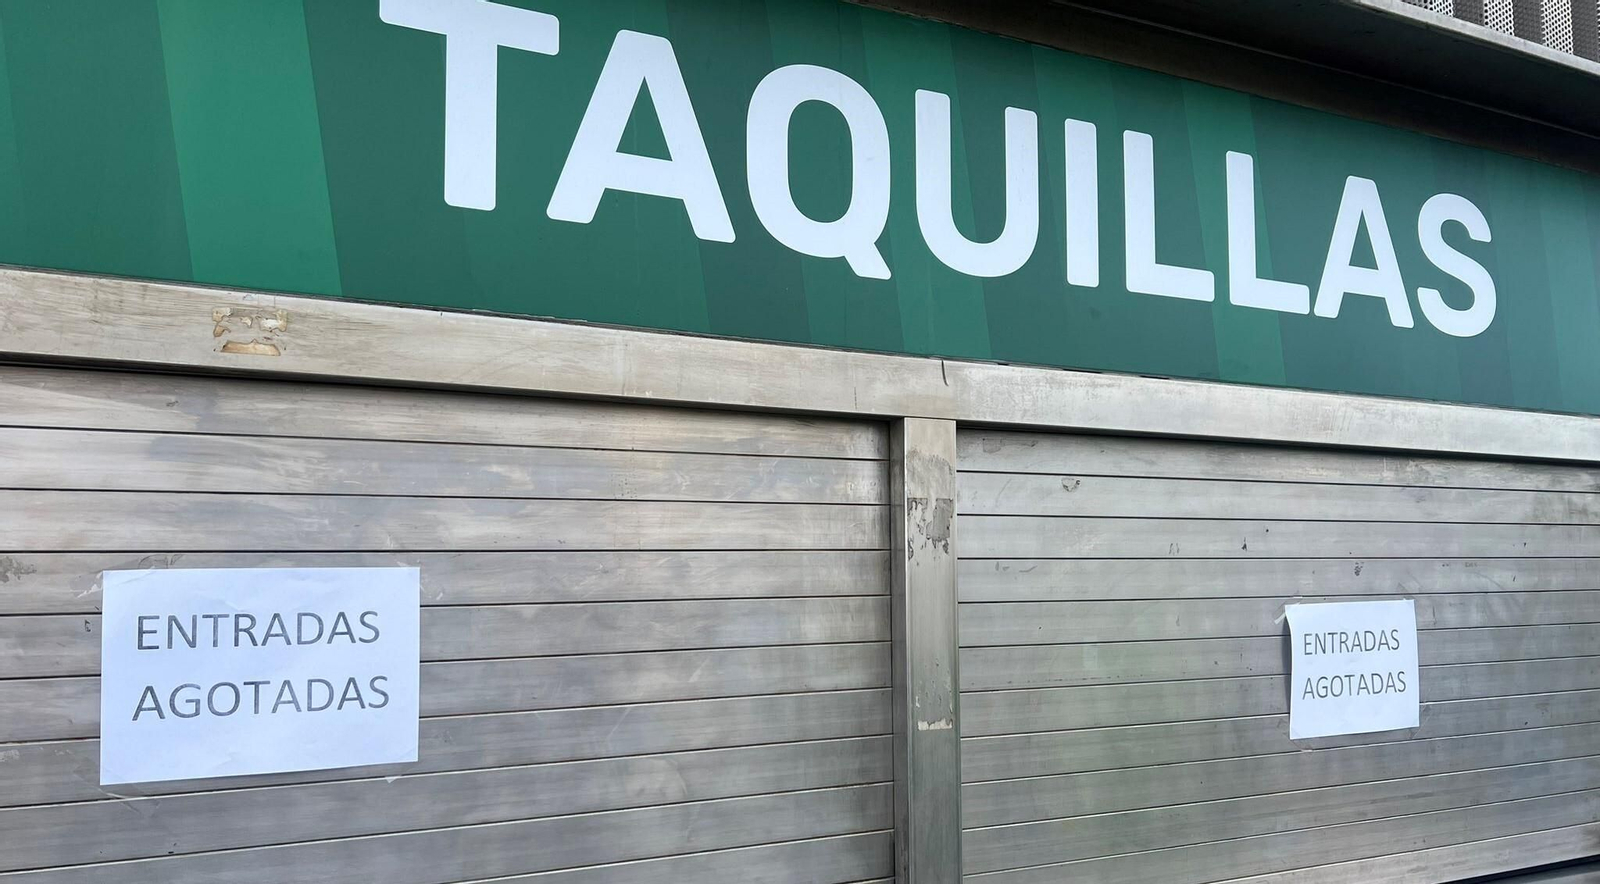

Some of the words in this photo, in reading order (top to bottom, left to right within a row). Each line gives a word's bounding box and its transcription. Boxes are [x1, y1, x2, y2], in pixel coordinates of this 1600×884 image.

[379, 0, 1497, 337] TAQUILLAS
[136, 610, 381, 651] ENTRADAS
[1302, 628, 1401, 656] ENTRADAS
[131, 675, 390, 722] AGOTADAS
[1301, 670, 1407, 700] AGOTADAS
